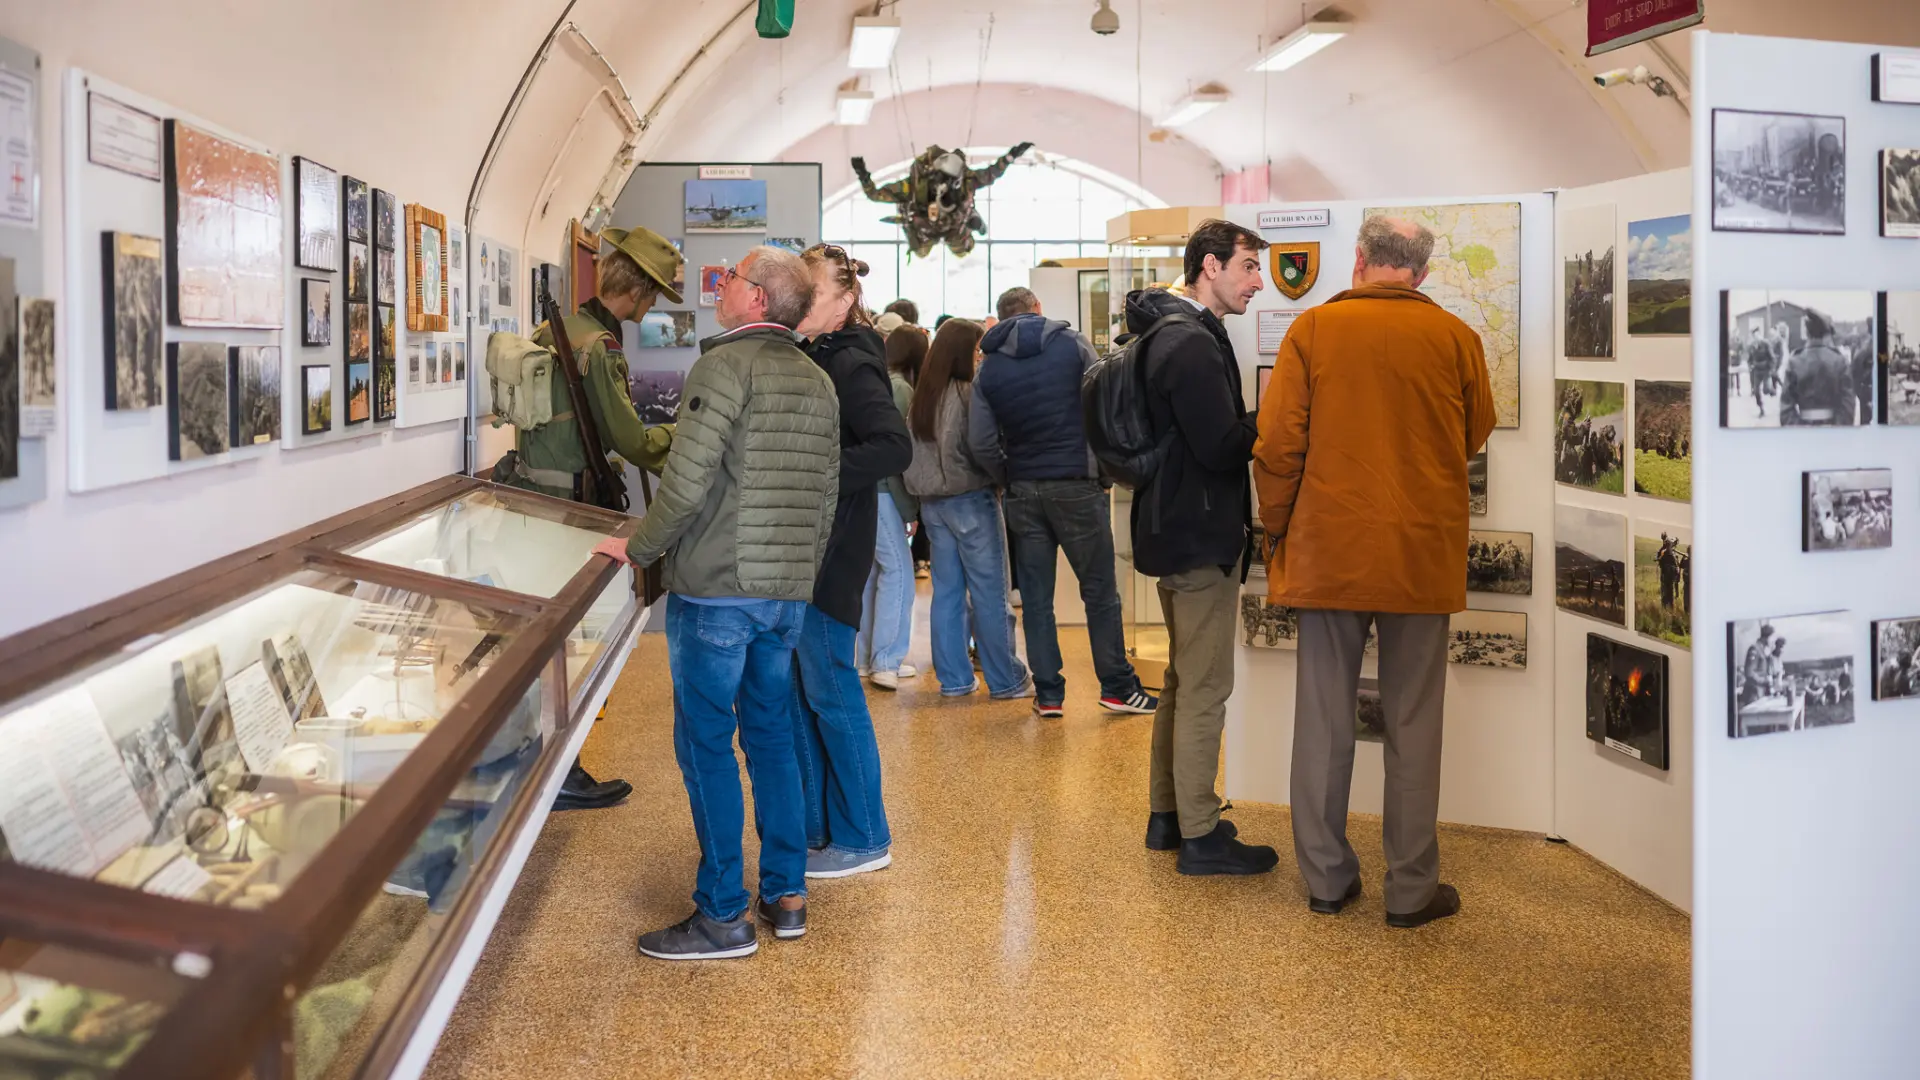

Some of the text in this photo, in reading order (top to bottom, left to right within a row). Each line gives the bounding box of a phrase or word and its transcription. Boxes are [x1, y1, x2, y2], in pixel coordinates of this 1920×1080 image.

[1624, 7, 1634, 23] DE
[1635, 0, 1654, 18] STAD
[705, 168, 746, 176] AIRBORNE
[1262, 214, 1323, 223] OTTERBURN (UK)
